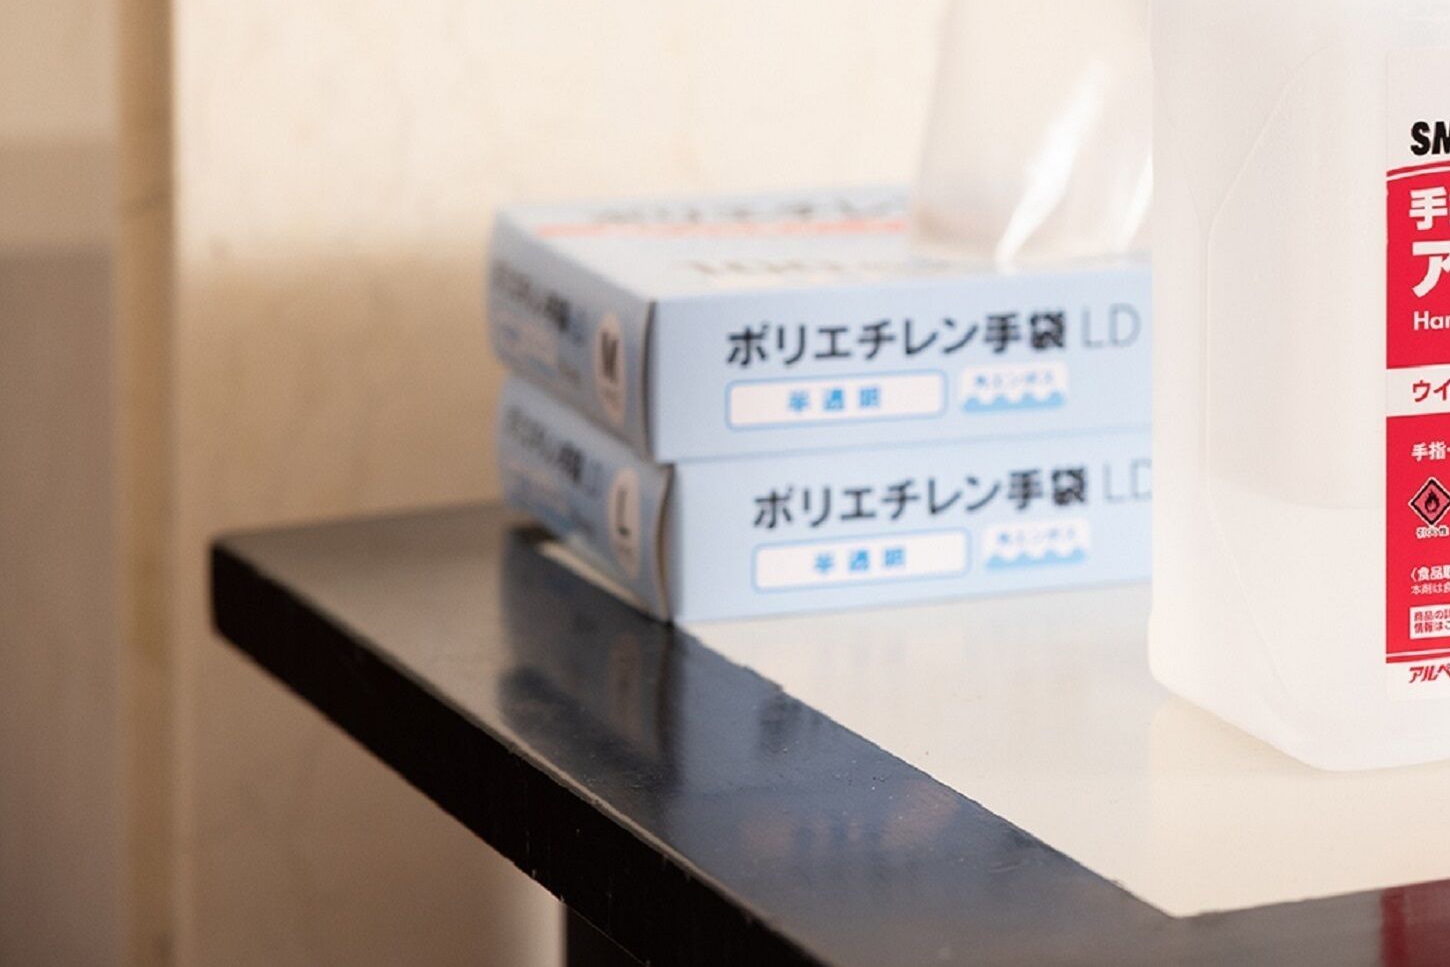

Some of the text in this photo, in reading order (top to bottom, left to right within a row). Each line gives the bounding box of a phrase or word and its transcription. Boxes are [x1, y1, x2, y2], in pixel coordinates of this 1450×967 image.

[725, 302, 1142, 368] ポリエチレン手袋 LD
[752, 464, 1089, 530] ポリエチレン手袋
